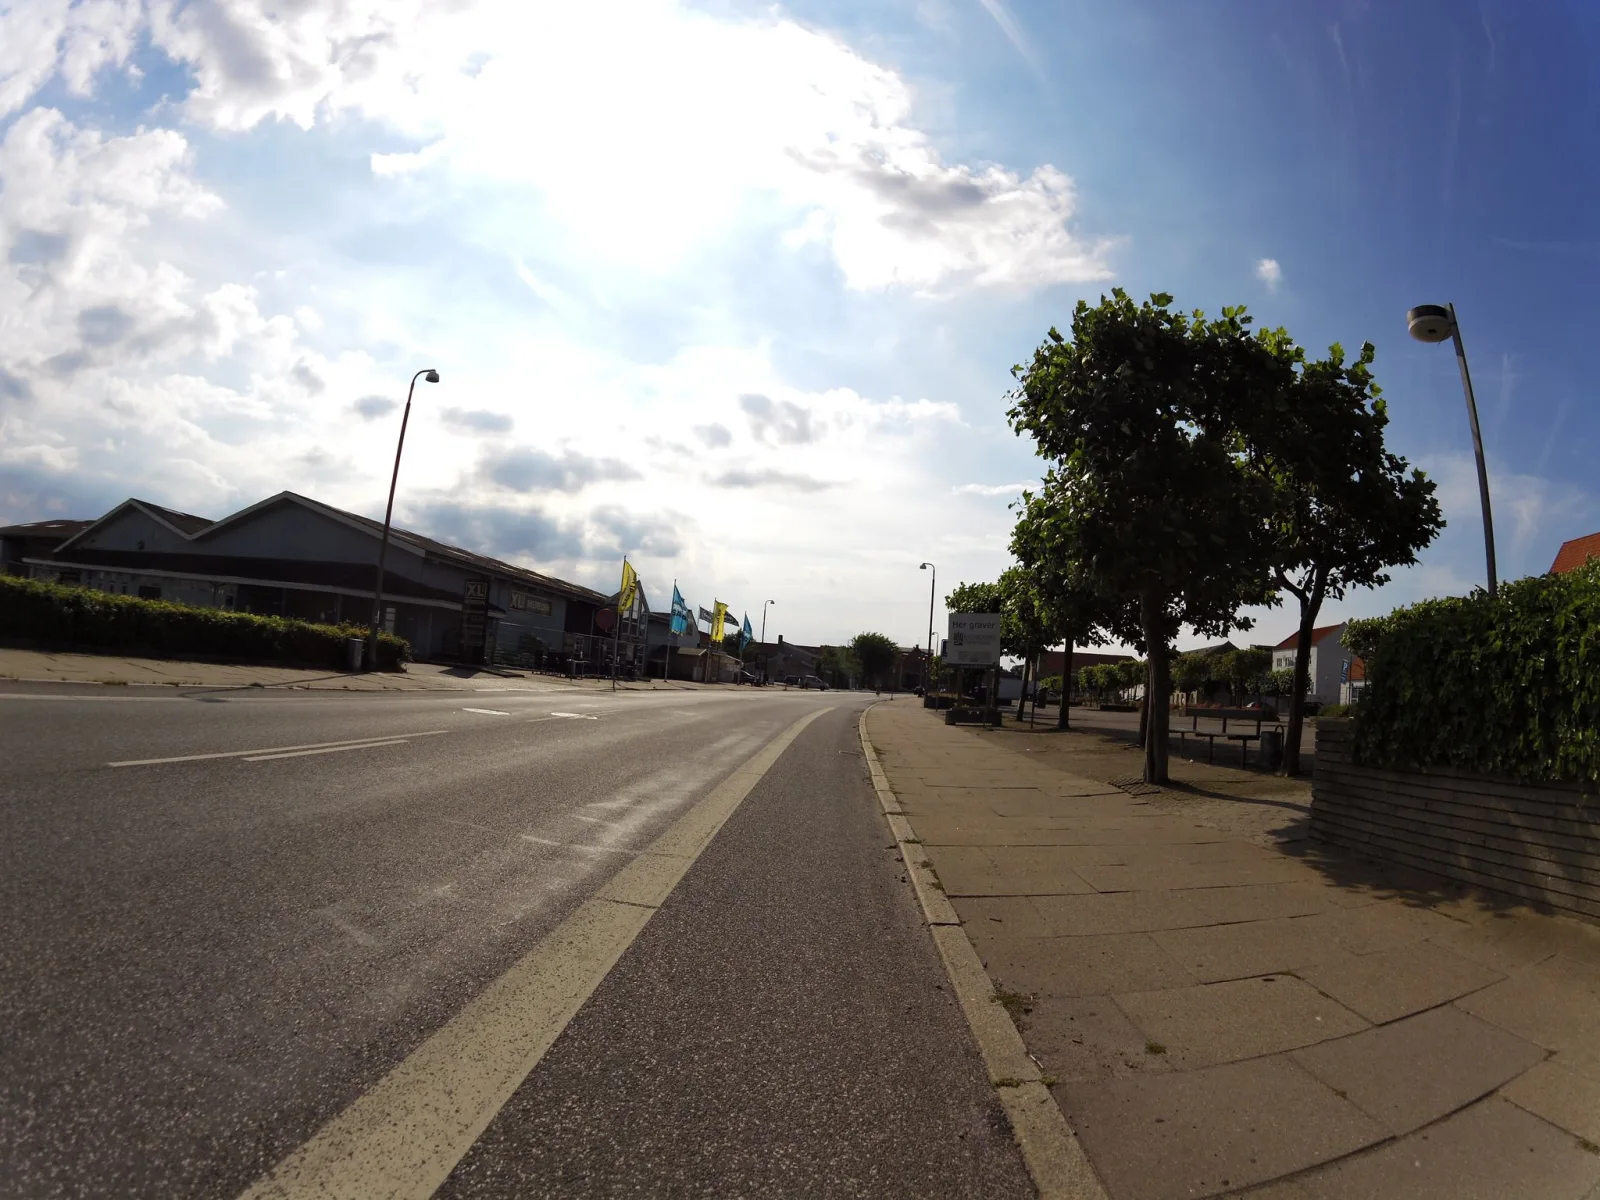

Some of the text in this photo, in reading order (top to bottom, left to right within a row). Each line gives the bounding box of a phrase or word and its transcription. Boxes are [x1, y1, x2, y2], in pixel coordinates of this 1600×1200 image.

[952, 620, 996, 631] Her graver
[1343, 662, 1348, 671] P
